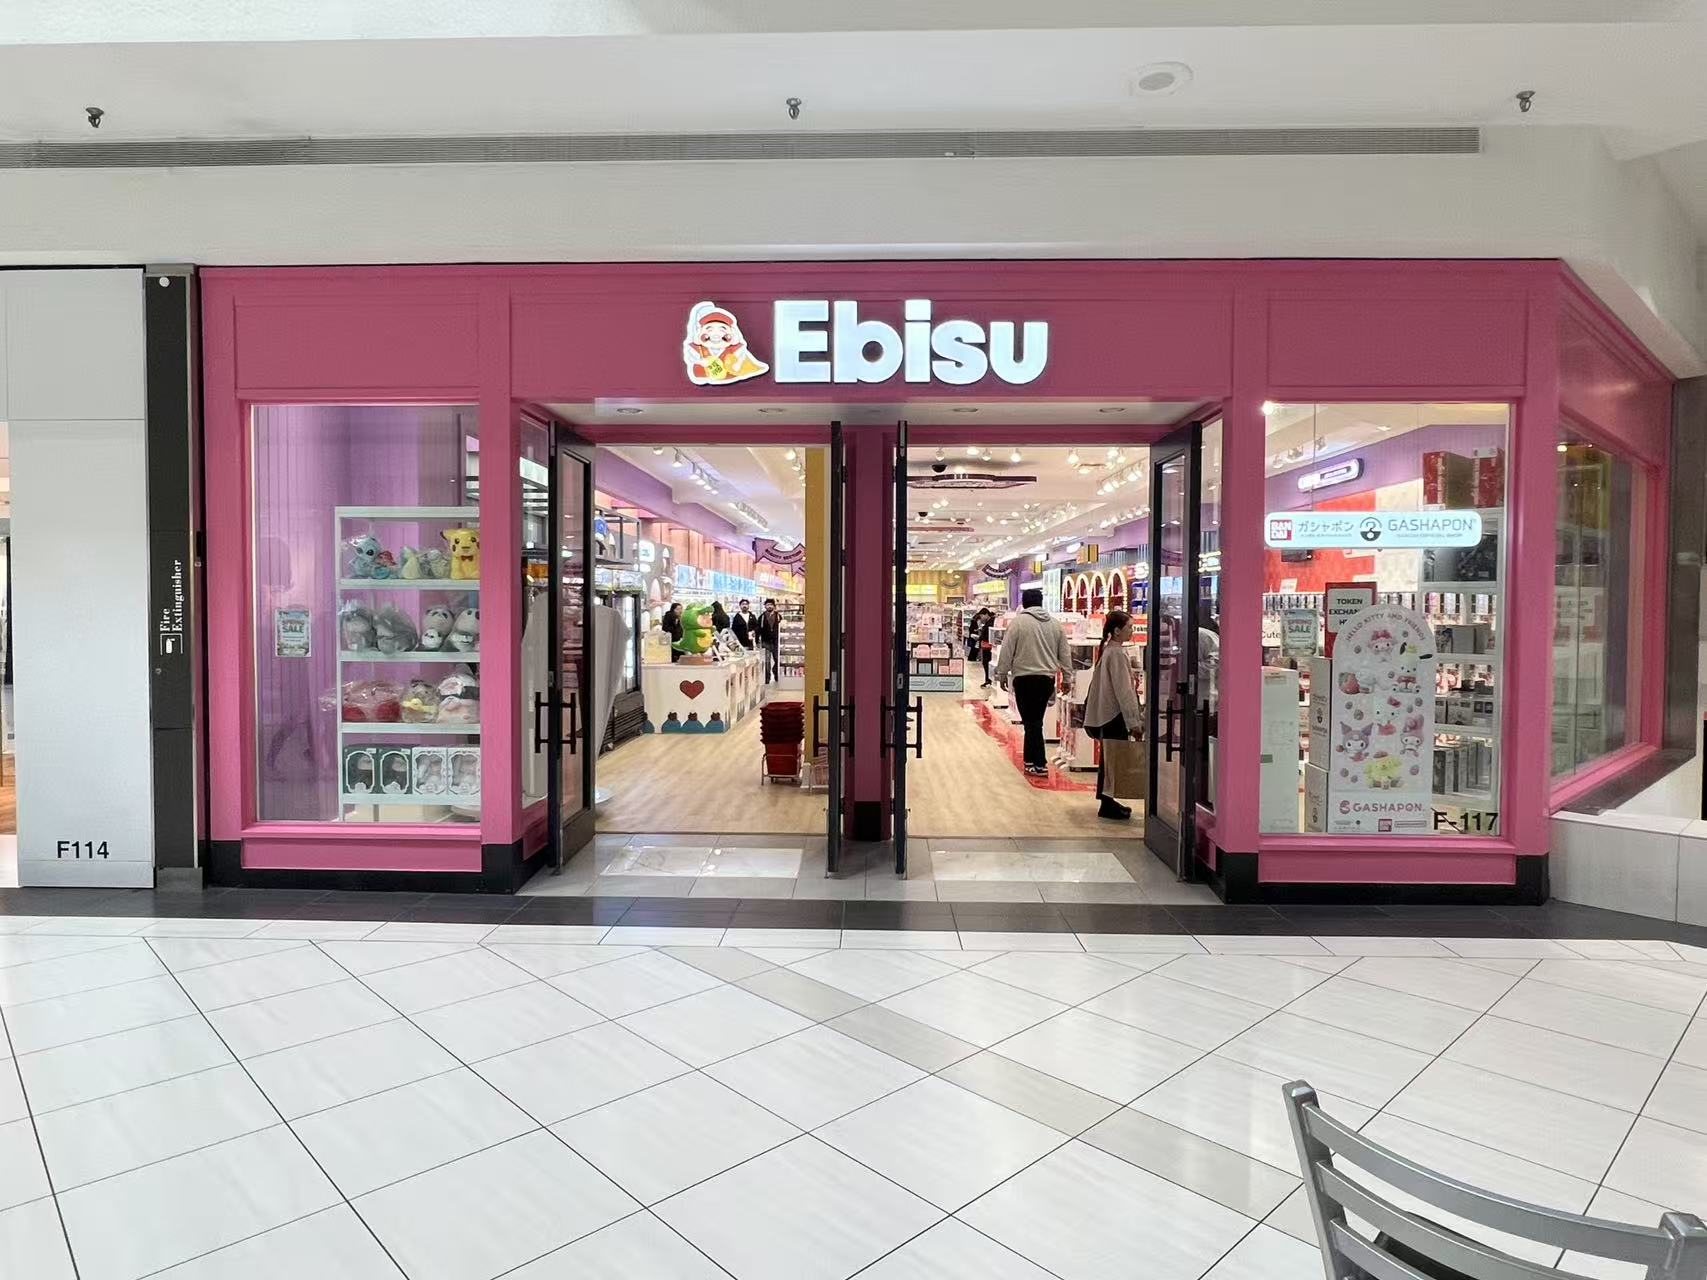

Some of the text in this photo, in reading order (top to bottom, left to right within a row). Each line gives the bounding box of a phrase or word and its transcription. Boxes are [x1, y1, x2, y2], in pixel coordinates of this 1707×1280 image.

[774, 299, 1049, 385] Ebisu
[1271, 520, 1292, 530] BAN
[1298, 520, 1354, 532] ガシャポン
[1388, 519, 1473, 531] GASHAPON
[171, 559, 185, 632] Extinguisher
[160, 608, 170, 632] Fire
[1345, 622, 1363, 641] HELLO
[1363, 613, 1384, 623] KITTY
[1288, 625, 1311, 633] SALE
[1352, 802, 1422, 812] GASHAPON
[1434, 811, 1498, 831] F-117
[57, 841, 109, 858] F114
